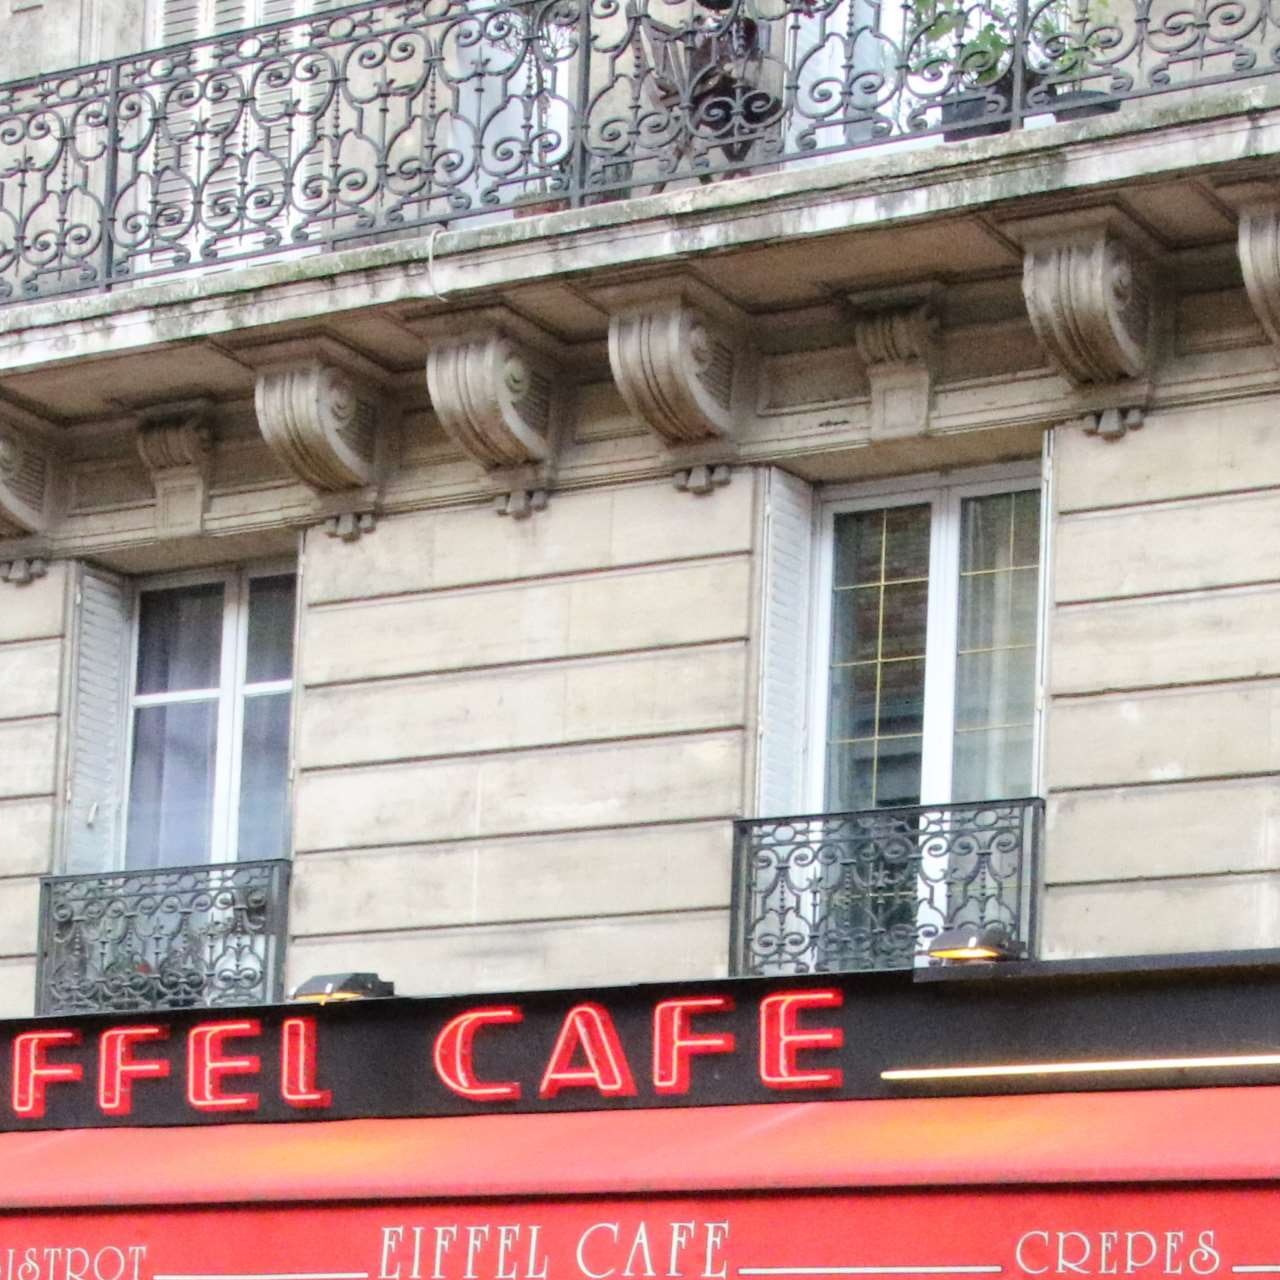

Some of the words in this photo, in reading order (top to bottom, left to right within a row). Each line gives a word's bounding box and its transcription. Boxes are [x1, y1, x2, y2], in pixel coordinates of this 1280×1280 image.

[432, 988, 845, 1102] CAFE
[575, 1221, 731, 1280] CAFE
[1015, 1231, 1223, 1276] CREPES
